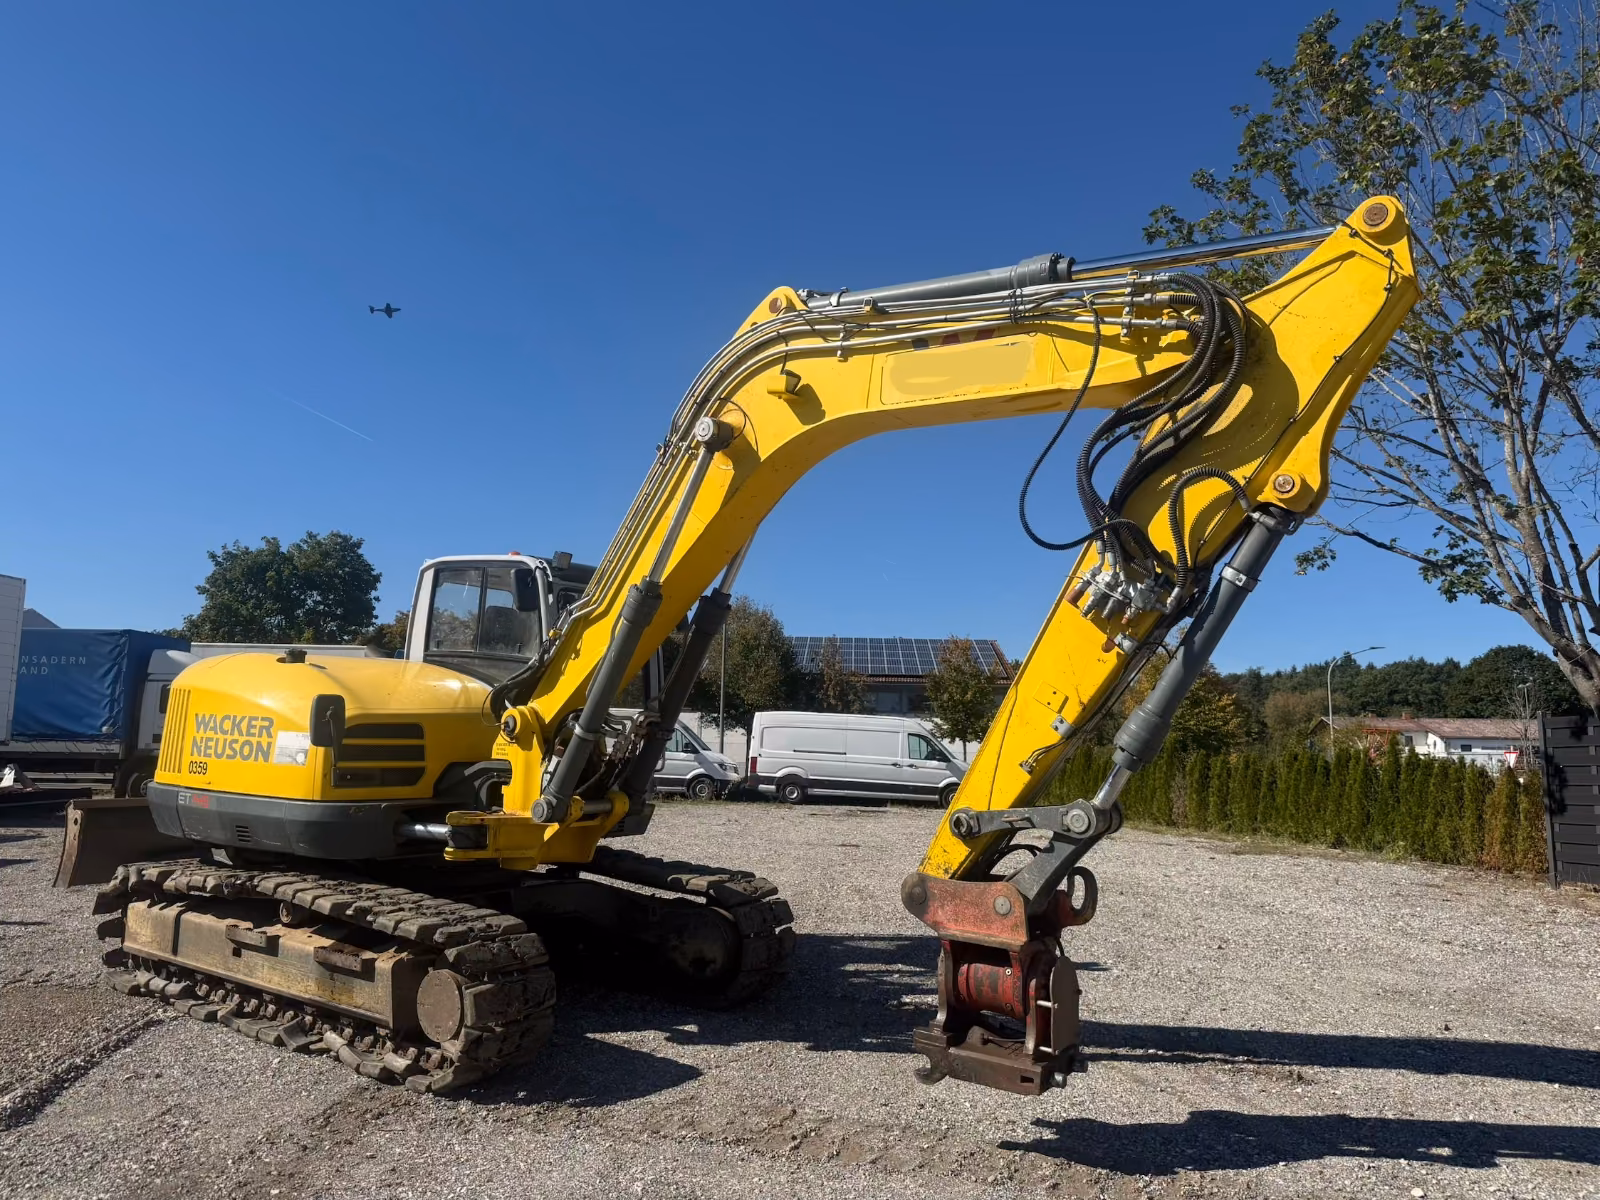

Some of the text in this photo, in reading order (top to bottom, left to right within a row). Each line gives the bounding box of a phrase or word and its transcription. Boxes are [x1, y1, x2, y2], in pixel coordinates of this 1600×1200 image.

[194, 712, 275, 739] WACKER
[190, 735, 273, 763] NEUSON
[188, 760, 208, 775] 0359
